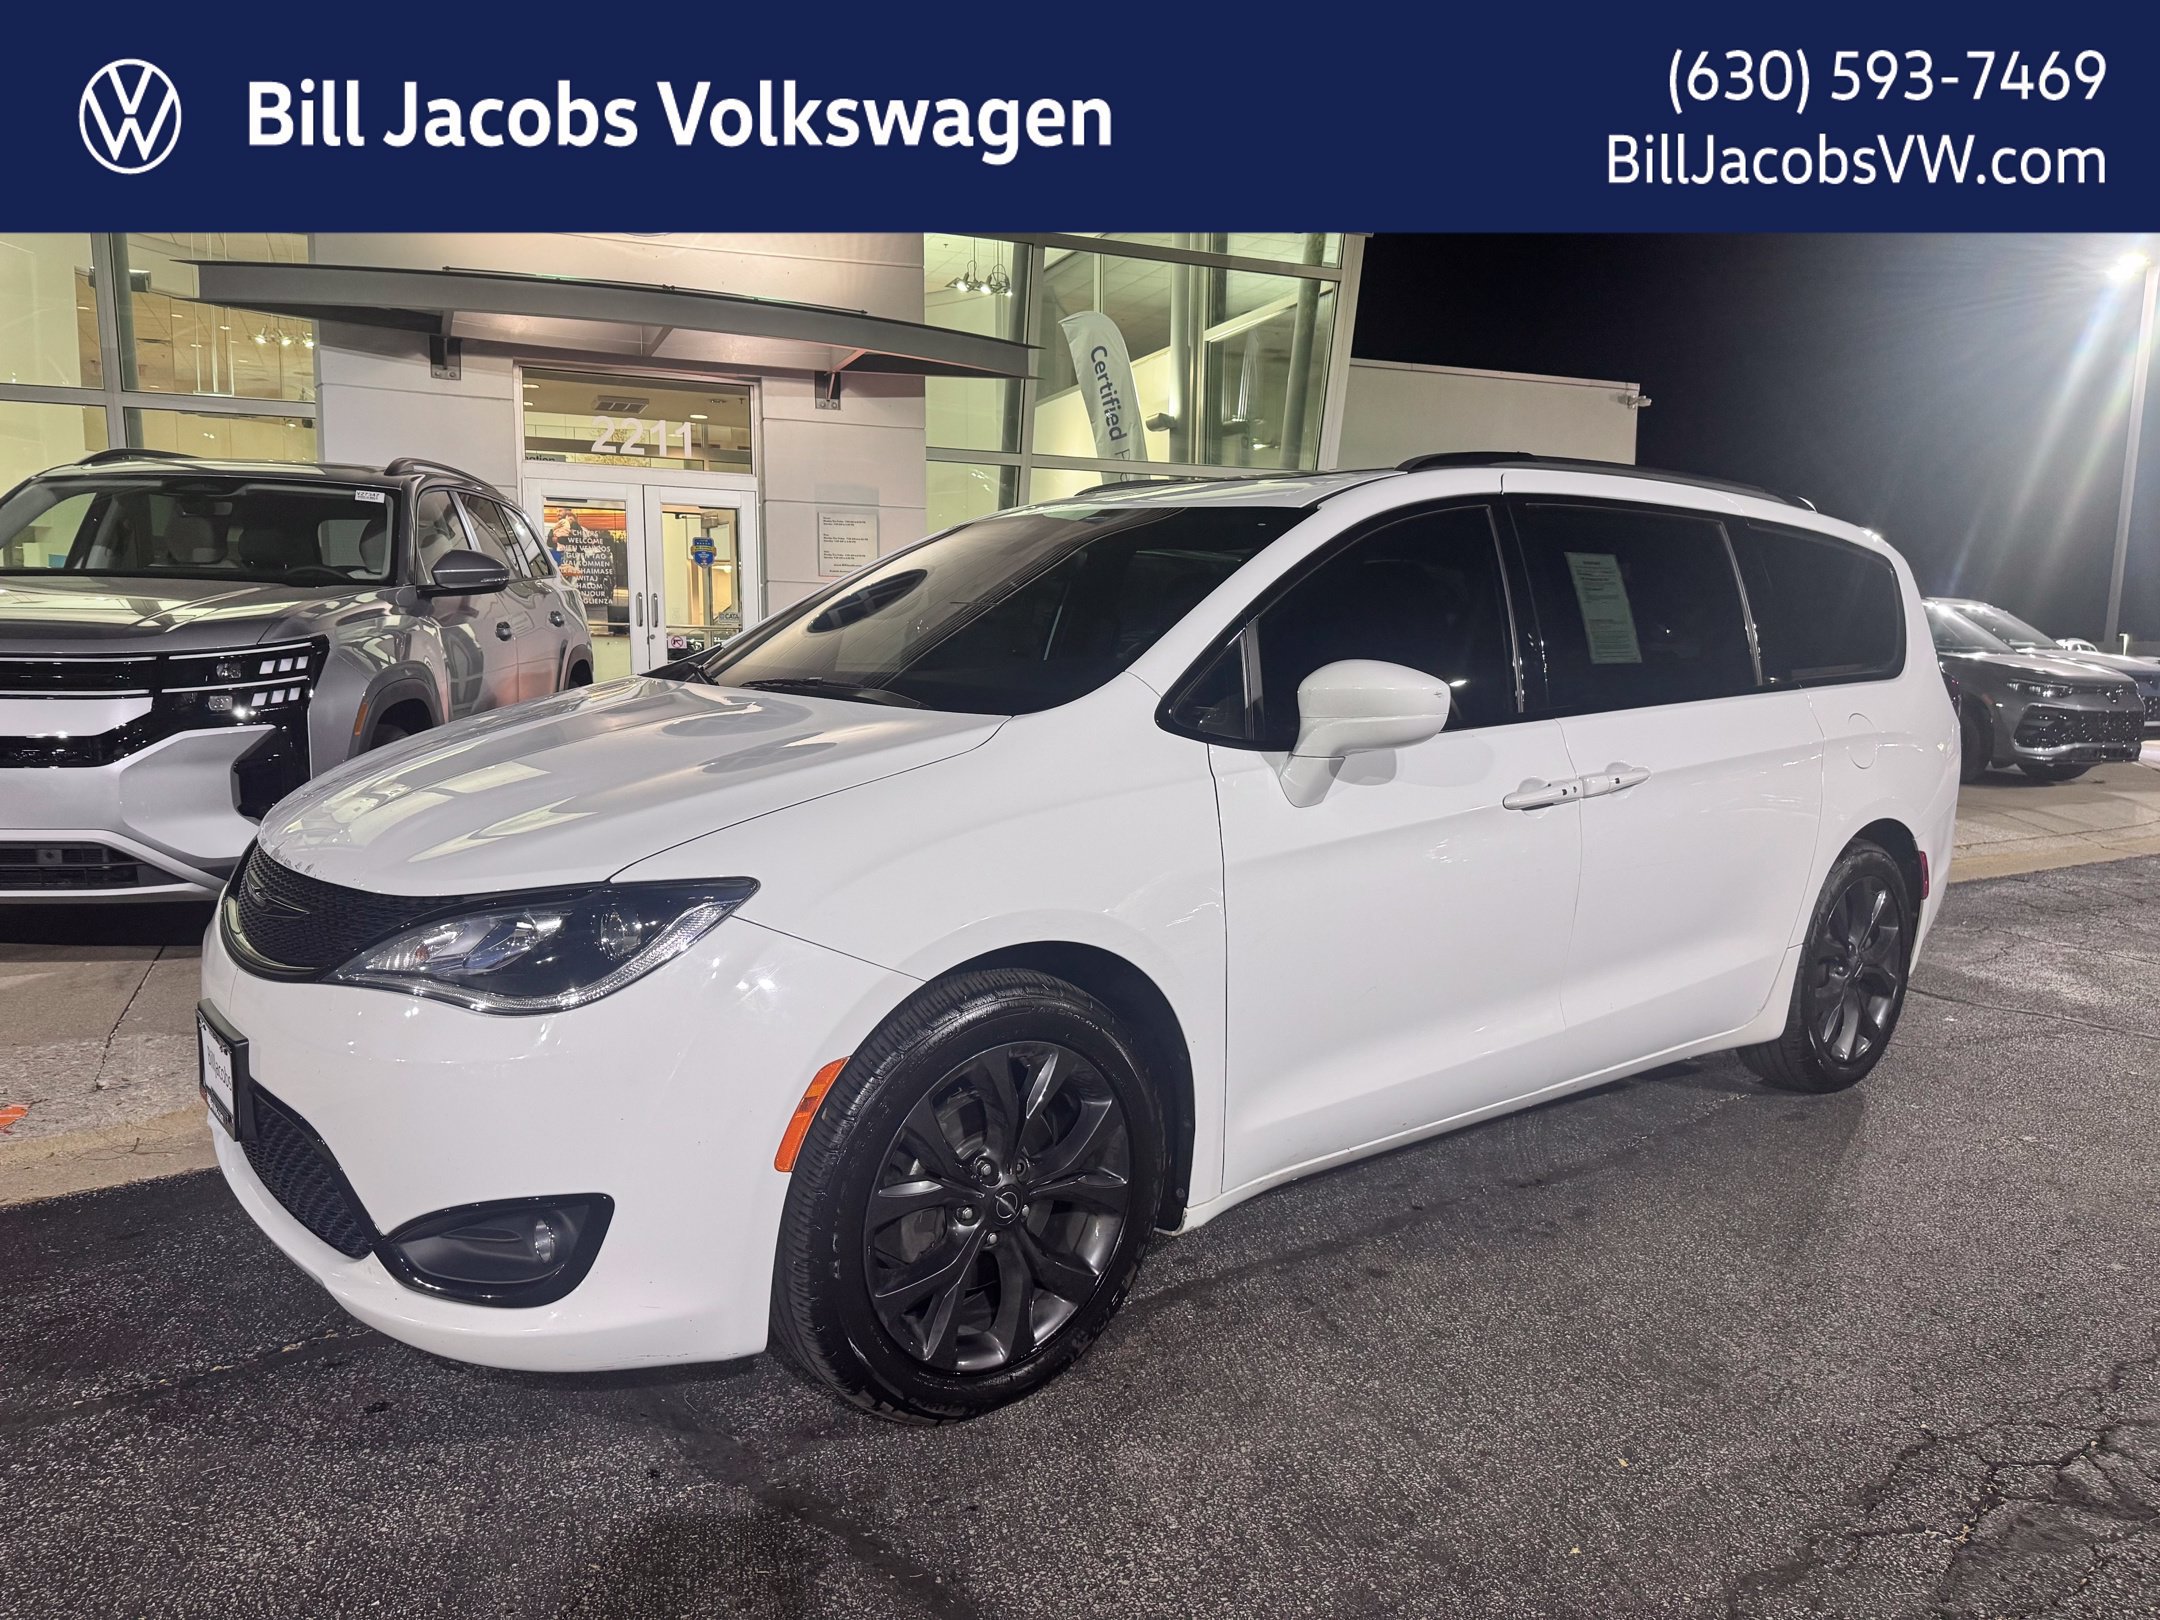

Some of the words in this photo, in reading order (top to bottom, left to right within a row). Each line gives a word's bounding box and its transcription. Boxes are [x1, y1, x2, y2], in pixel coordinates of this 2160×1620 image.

[1090, 345, 1127, 442] Certified
[591, 416, 693, 459] 2211
[567, 537, 604, 545] WELCOME
[576, 583, 603, 591] HALOM
